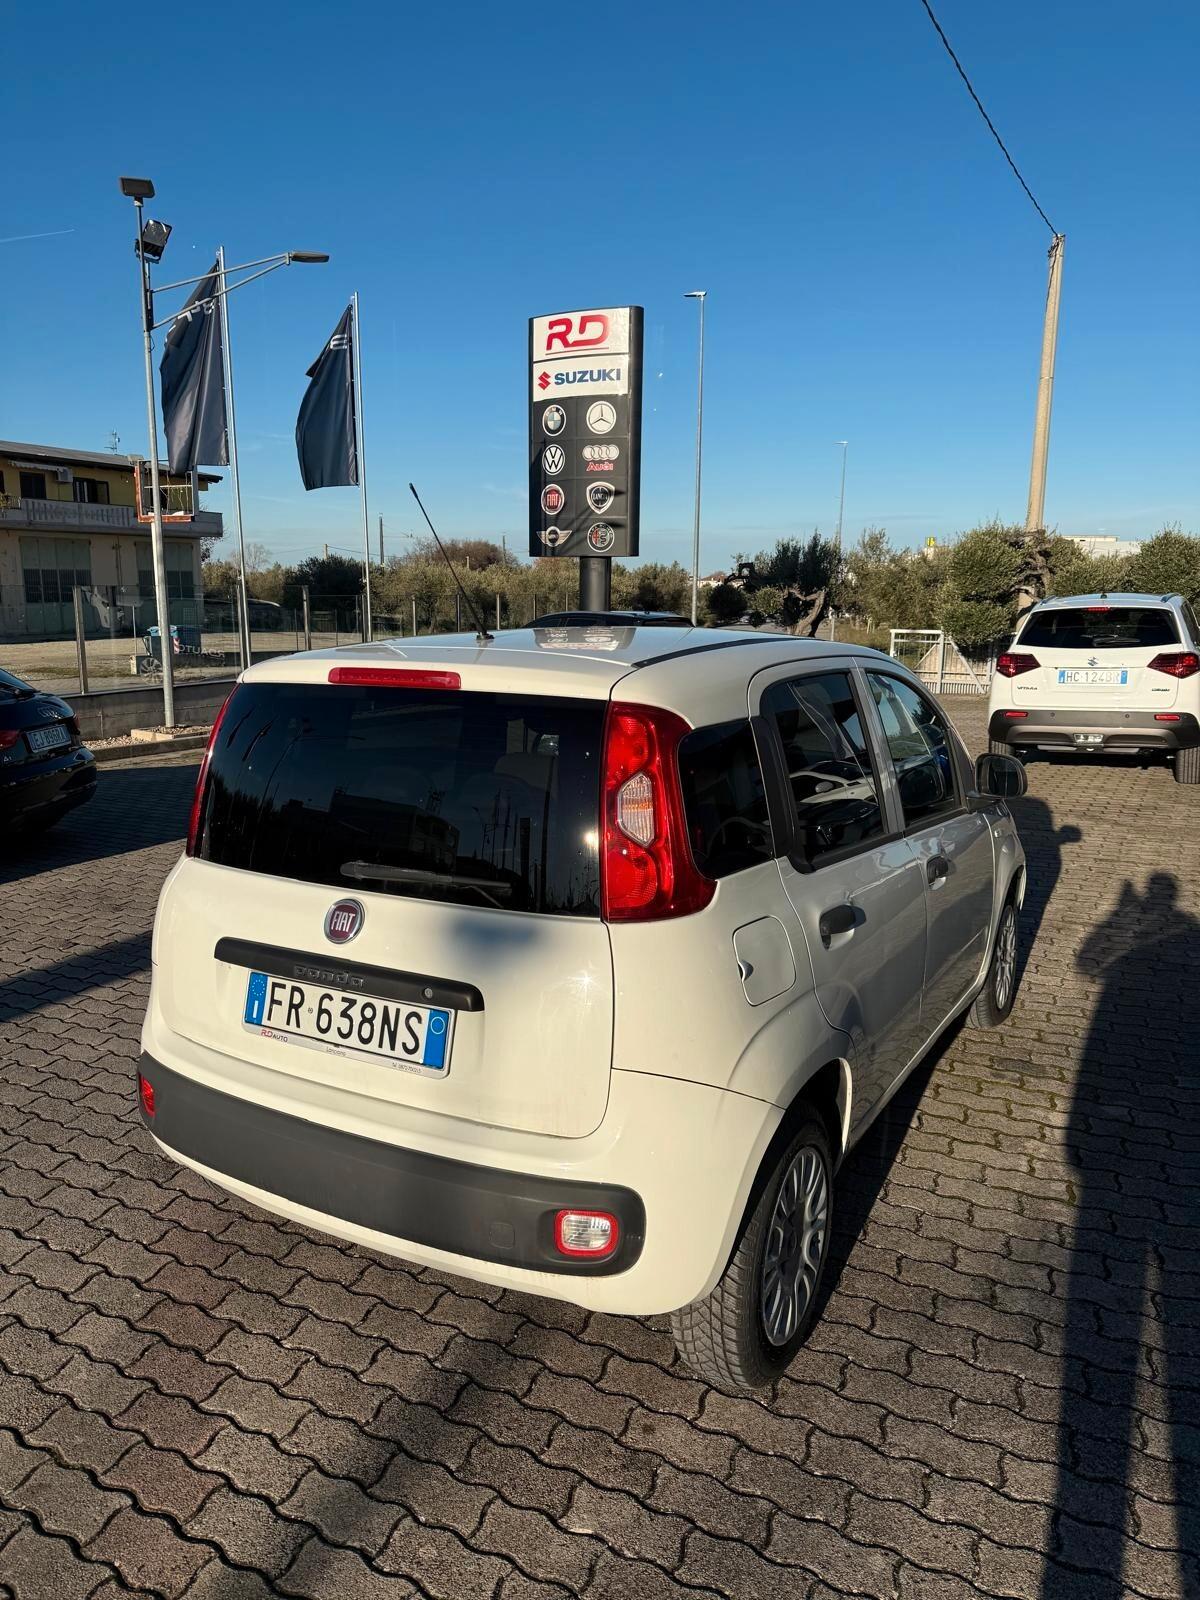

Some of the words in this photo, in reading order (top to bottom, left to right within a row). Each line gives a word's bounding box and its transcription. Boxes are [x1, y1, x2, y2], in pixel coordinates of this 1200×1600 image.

[546, 314, 609, 351] RD
[554, 368, 621, 386] SUZUKI
[586, 461, 614, 471] Audi
[546, 493, 559, 507] FIAT
[1066, 670, 1080, 682] HC
[331, 911, 355, 932] FIAT
[294, 965, 364, 987] panda
[267, 981, 306, 1029] FR
[316, 993, 422, 1056] 638NS
